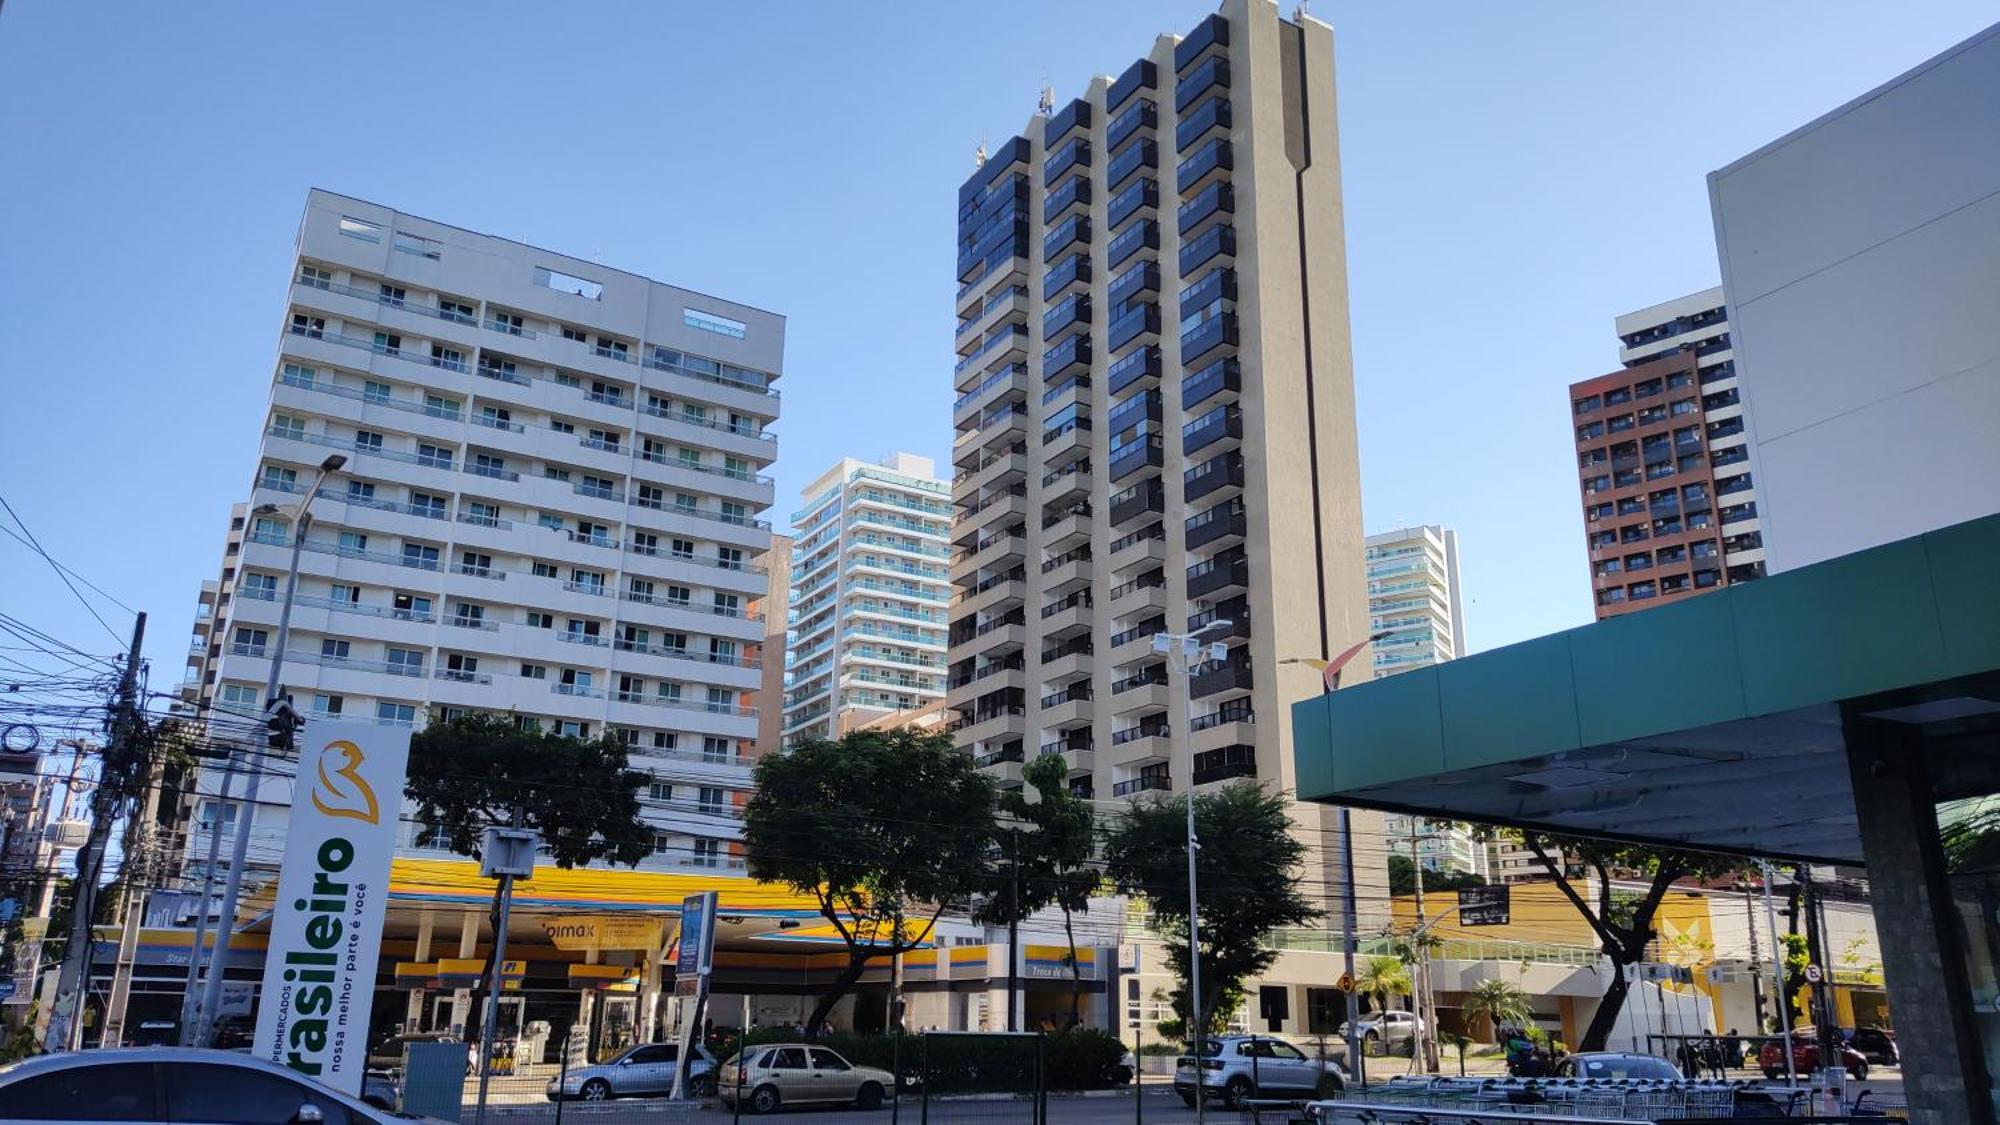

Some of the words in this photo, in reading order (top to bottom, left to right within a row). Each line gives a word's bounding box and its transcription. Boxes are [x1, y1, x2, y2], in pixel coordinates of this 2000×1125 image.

[354, 883, 367, 916] você
[349, 919, 361, 929] é
[284, 837, 355, 1076] rasileiro
[346, 934, 359, 971] parte
[338, 976, 353, 1026] melhor
[272, 985, 292, 1063] PERMERCADOS
[332, 1031, 345, 1073] nossa
